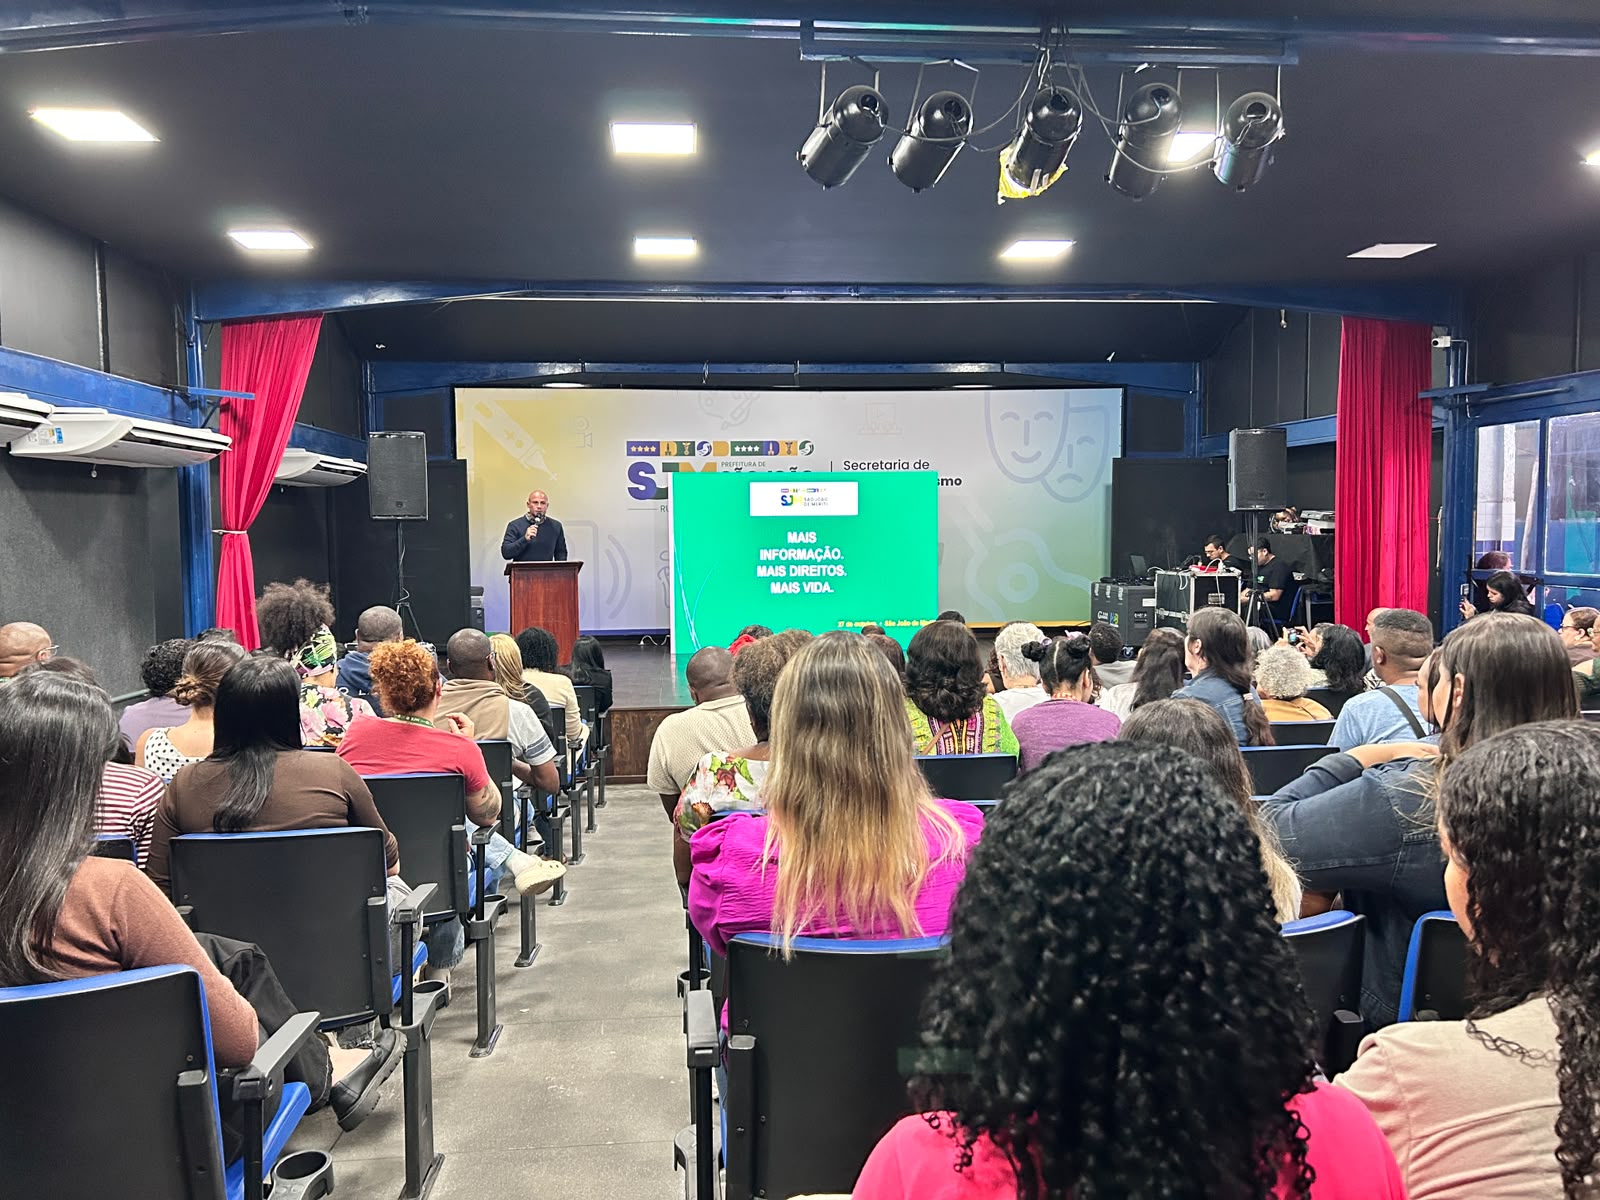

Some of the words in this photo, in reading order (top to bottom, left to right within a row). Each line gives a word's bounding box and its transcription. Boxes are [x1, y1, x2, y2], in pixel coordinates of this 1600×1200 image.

[843, 459, 910, 470] Secretaria
[913, 459, 930, 470] de
[787, 531, 817, 544] MAIS
[759, 545, 845, 563] INFORMAÇÃO.
[757, 565, 787, 577] MAIS
[789, 564, 848, 577] DIREITOS.
[770, 581, 801, 594] MAIS
[802, 581, 835, 593] VIDA.
